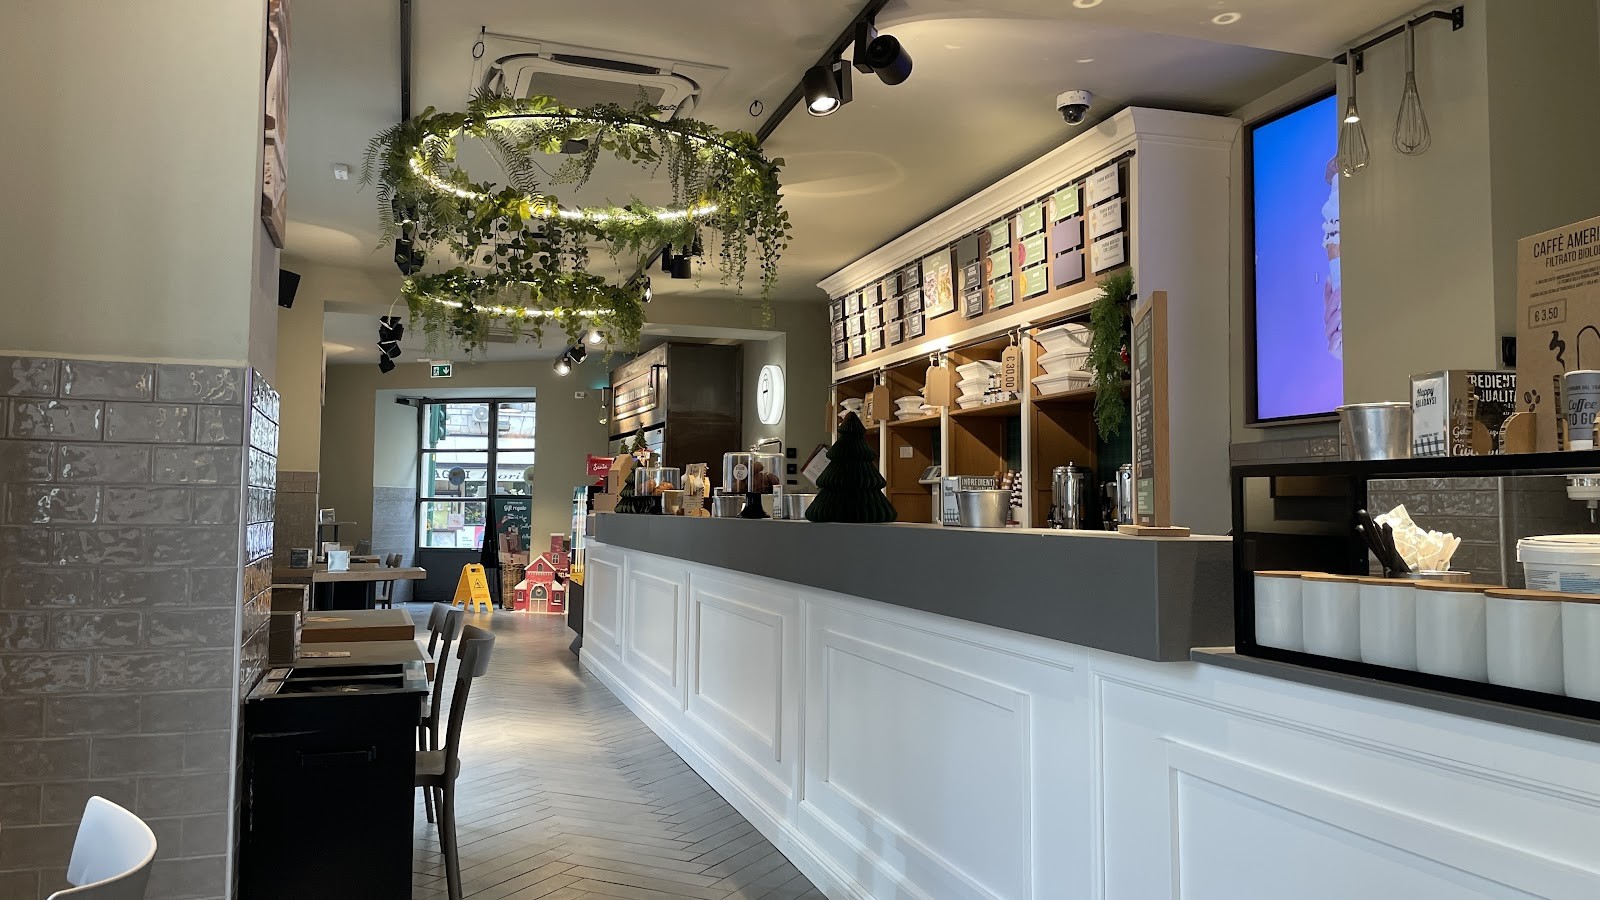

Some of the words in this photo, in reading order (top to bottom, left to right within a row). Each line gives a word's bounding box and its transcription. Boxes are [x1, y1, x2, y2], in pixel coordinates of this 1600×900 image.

[1533, 233, 1564, 258] CAFFÈ
[1567, 226, 1600, 249] AMERI
[1545, 251, 1577, 268] FILTRATO
[1534, 310, 1540, 322] €
[1541, 306, 1559, 321] 3,50
[1005, 363, 1015, 388] 30.00
[1416, 388, 1434, 398] Happy
[1568, 398, 1598, 413] Coffee
[1581, 412, 1597, 425] GO
